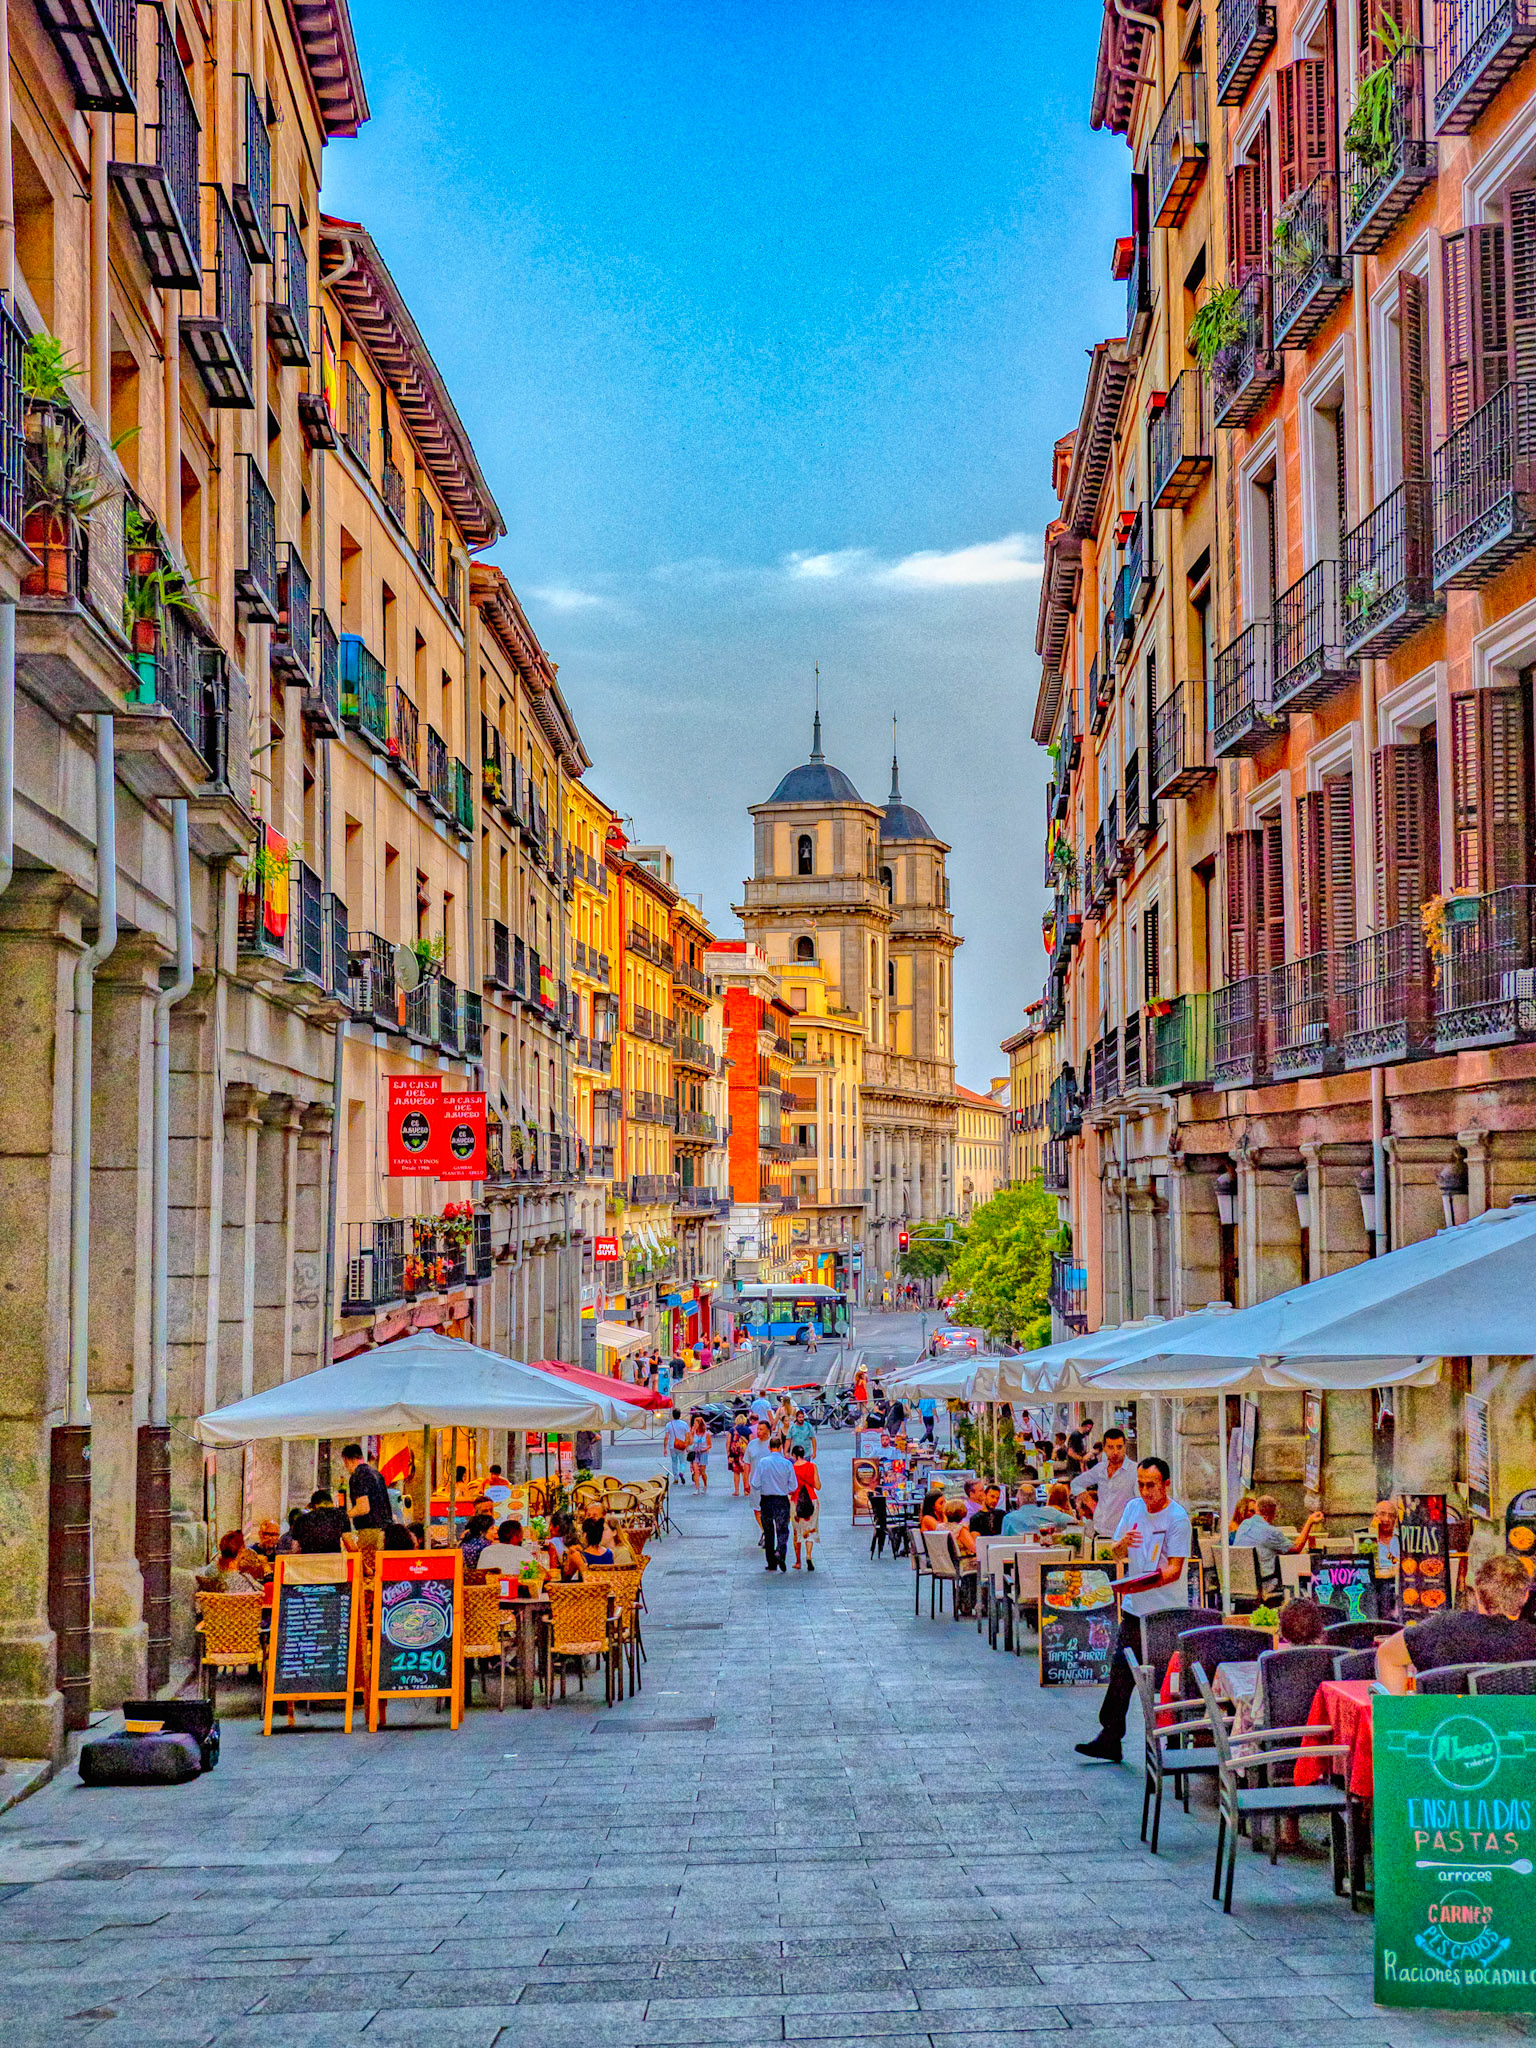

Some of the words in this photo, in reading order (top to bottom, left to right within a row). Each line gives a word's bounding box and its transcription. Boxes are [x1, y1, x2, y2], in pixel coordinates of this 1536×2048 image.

[405, 1089, 426, 1097] DEL
[409, 1081, 438, 1089] CASA
[393, 1097, 435, 1105] ABUELO
[1401, 1526, 1440, 1555] PIZZAS
[382, 1581, 413, 1602] OFERTA
[1048, 1651, 1073, 1661] TAPAS
[1078, 1650, 1107, 1661] JARRA
[1067, 1661, 1079, 1669] DE
[1407, 1798, 1531, 1831] ENSALADAS
[1414, 1830, 1519, 1854] PASTAS
[1438, 1870, 1492, 1882] arroces
[1428, 1904, 1494, 1924] CARNES
[1383, 1948, 1461, 1986] Raciones
